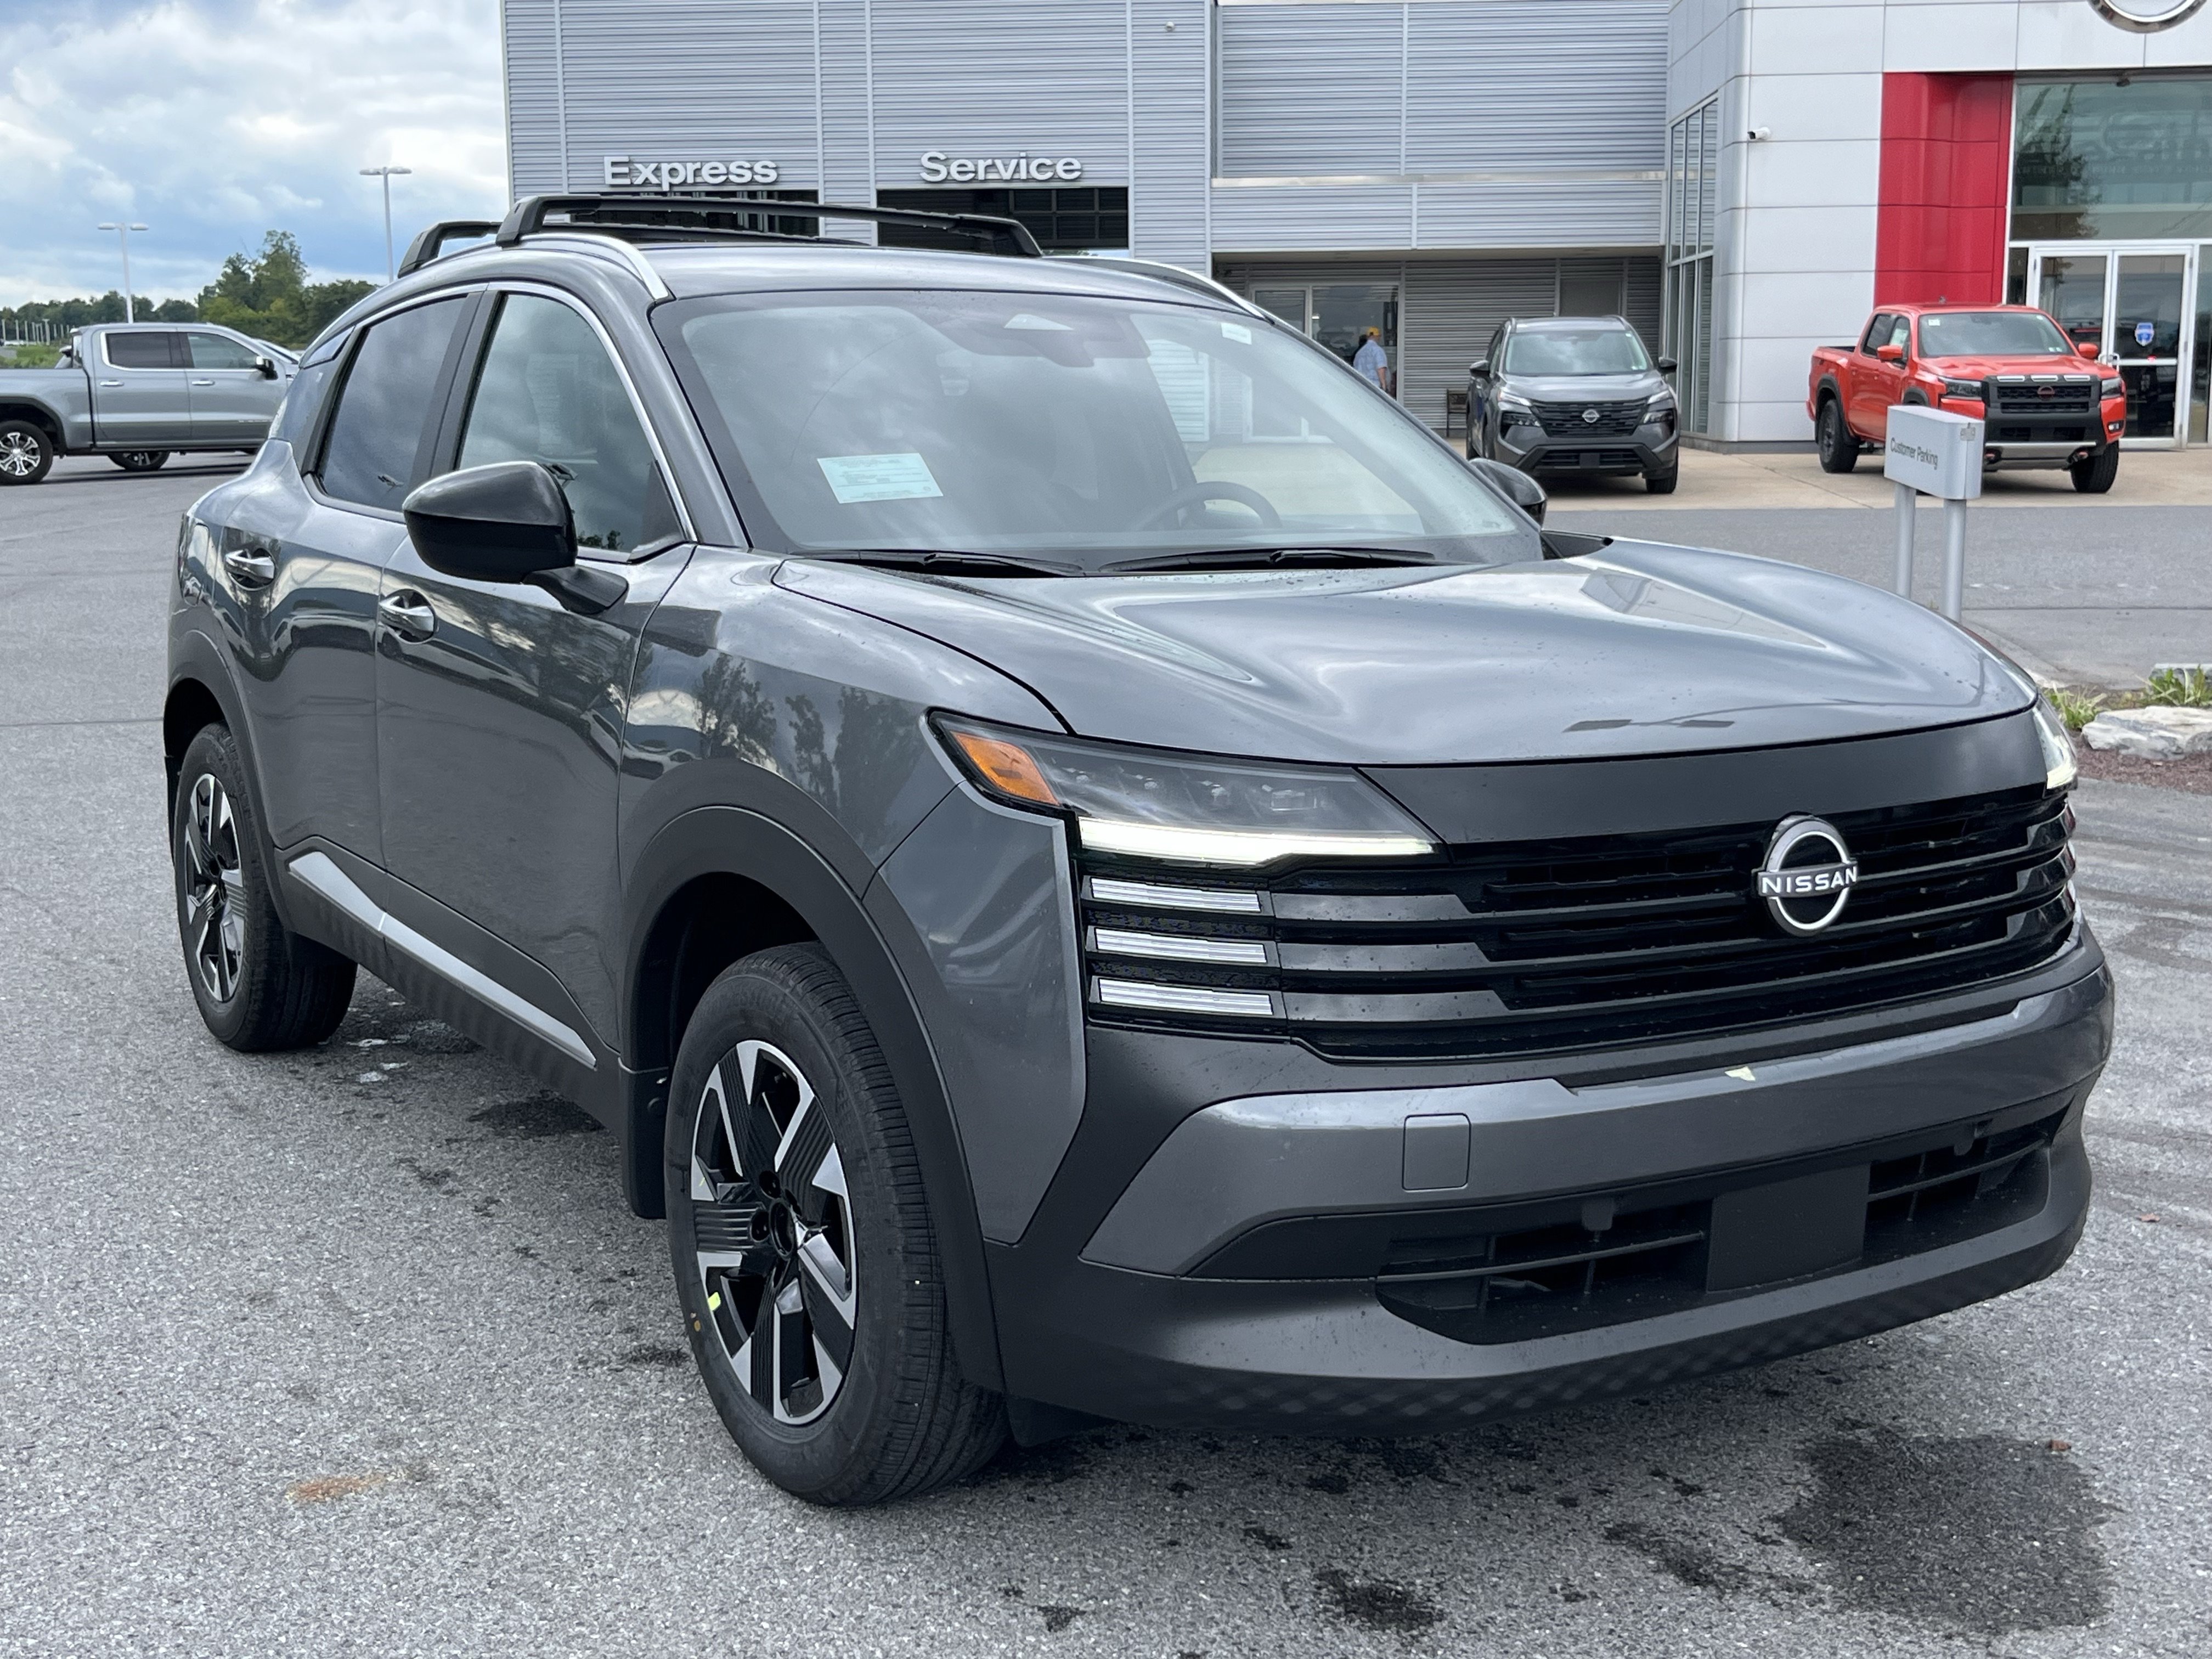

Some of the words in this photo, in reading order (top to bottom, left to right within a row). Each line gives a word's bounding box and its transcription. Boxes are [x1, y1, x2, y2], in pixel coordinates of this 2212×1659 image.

[603, 155, 778, 191] Express
[919, 151, 1082, 183] Service
[1891, 437, 1916, 459] Customer
[1916, 445, 1938, 470] Parking
[1762, 866, 1858, 894] NISSAN
